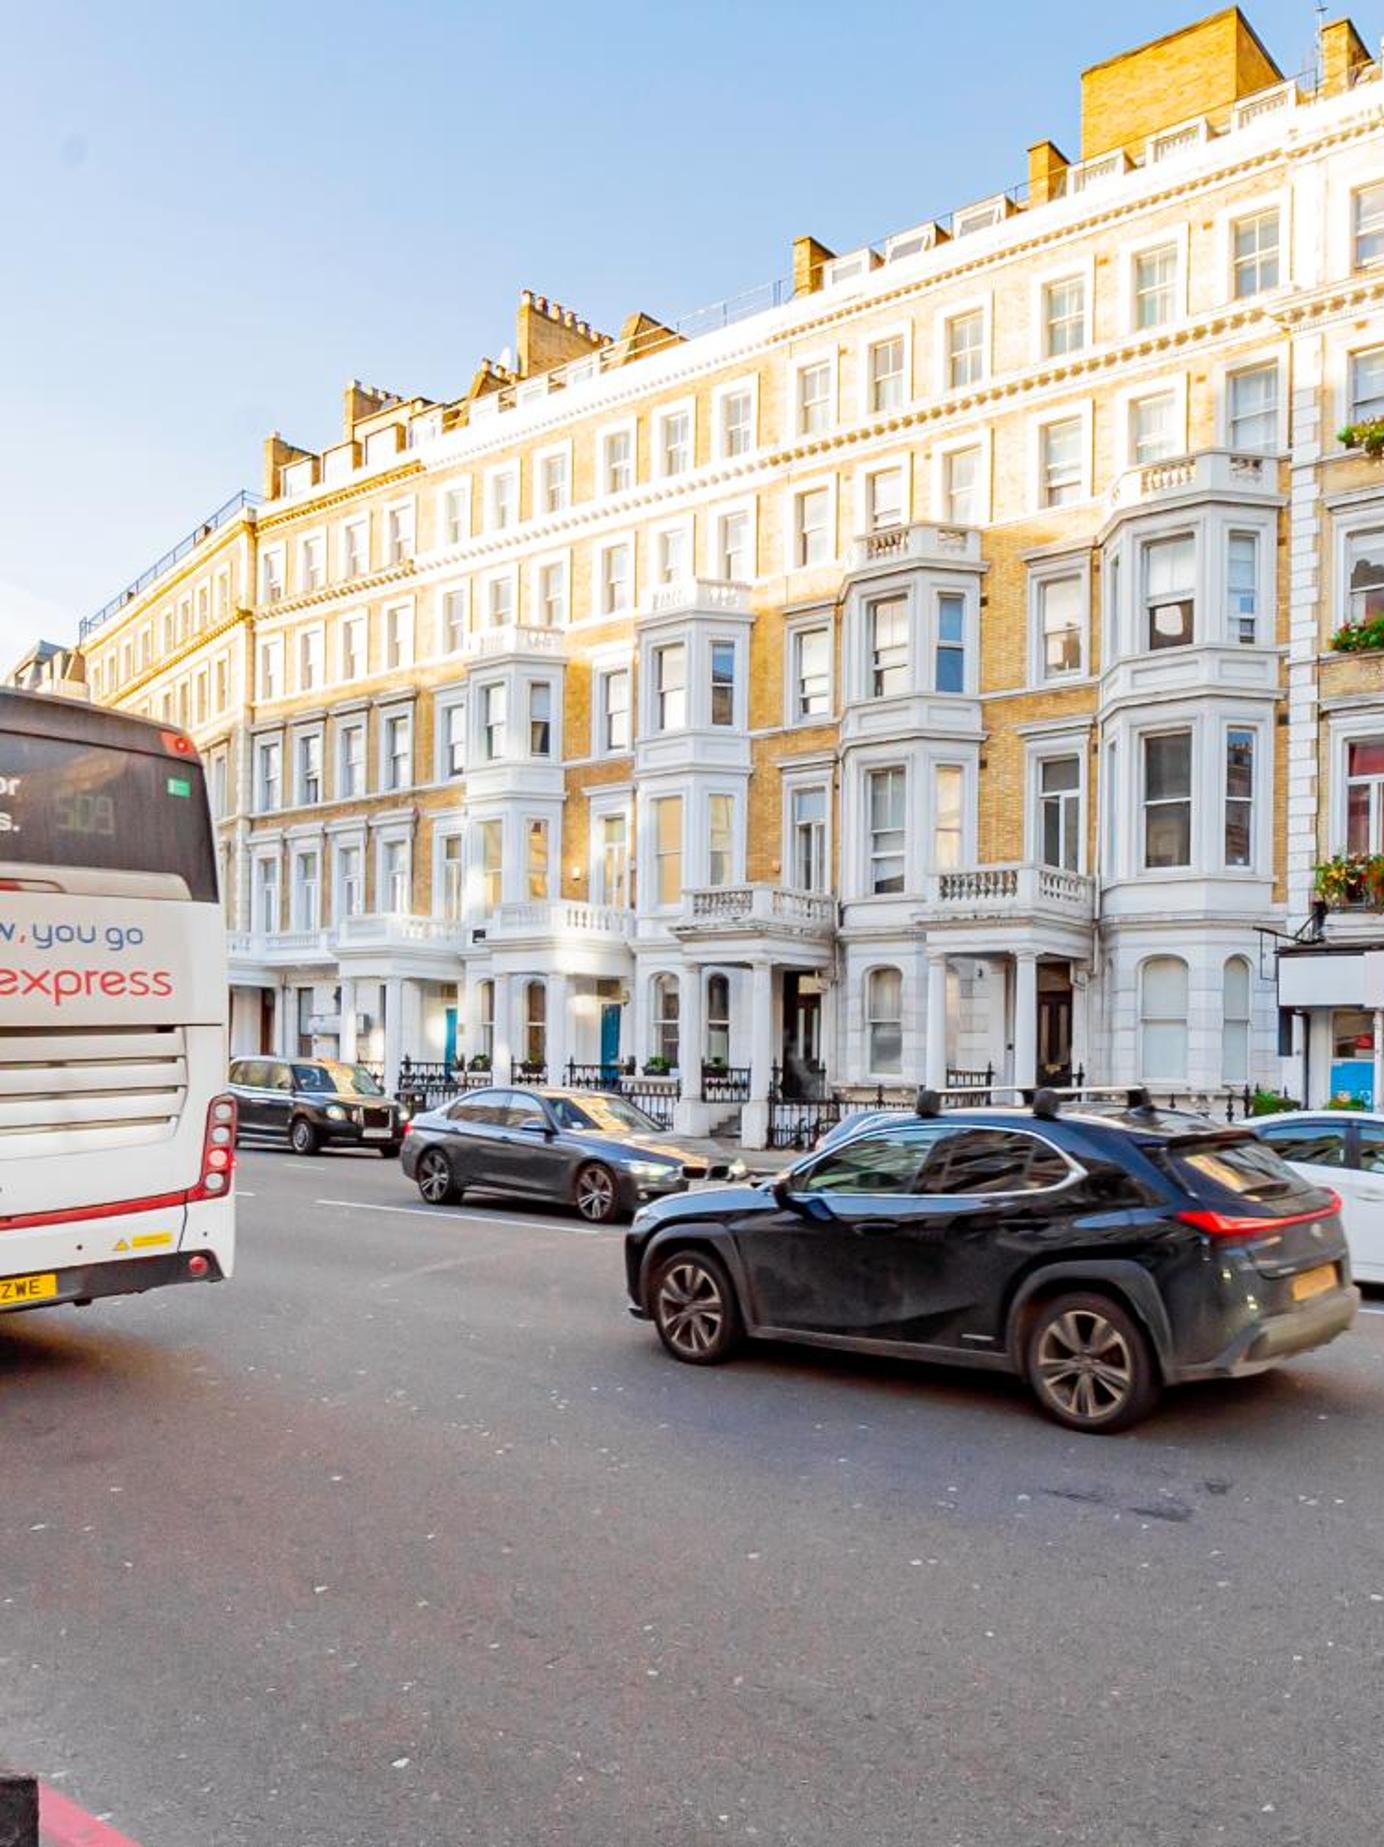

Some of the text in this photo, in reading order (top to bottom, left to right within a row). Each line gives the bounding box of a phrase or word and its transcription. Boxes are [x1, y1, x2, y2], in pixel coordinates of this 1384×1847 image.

[32, 921, 97, 950] you
[105, 926, 144, 951] go
[0, 967, 173, 1006] express
